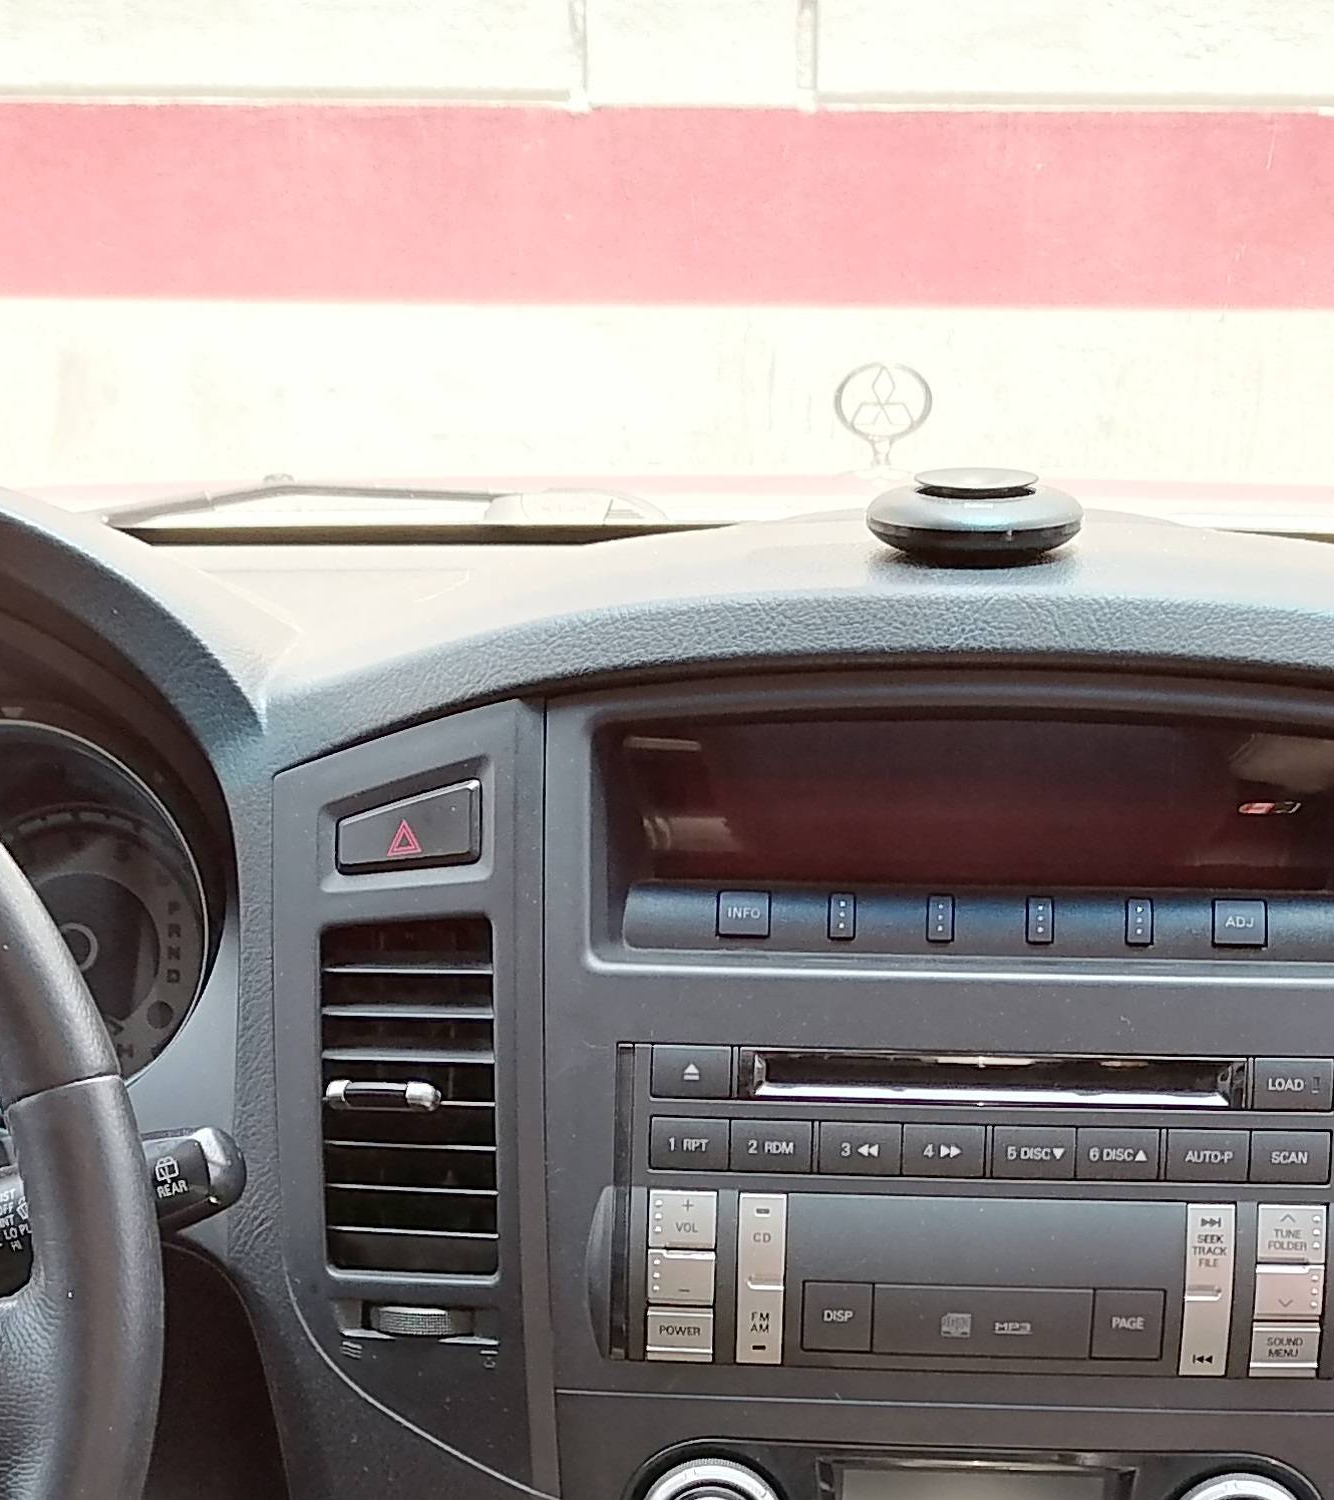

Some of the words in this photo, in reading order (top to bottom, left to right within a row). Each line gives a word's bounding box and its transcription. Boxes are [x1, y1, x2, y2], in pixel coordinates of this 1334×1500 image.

[727, 907, 761, 919] INFO
[1225, 916, 1255, 928] ADJ
[1268, 1079, 1304, 1092] LOAD
[668, 1137, 675, 1151] 1
[683, 1138, 709, 1152] RPT
[748, 1140, 757, 1154] 2
[765, 1141, 794, 1155] RDM
[841, 1143, 851, 1157] 3
[923, 1144, 934, 1158] 4
[1007, 1147, 1017, 1160] 5
[1020, 1148, 1051, 1161] DISC
[1089, 1148, 1100, 1161] 6
[1102, 1149, 1135, 1162] DISC
[1271, 1151, 1308, 1164] SCAN
[156, 1180, 189, 1199] REAR
[3, 1227, 18, 1240] LO
[675, 1222, 699, 1233] VOL
[753, 1232, 772, 1244] CD
[1197, 1234, 1224, 1245] SEEK
[1274, 1229, 1302, 1240] TUNE
[1192, 1246, 1227, 1257] TRACK
[1267, 1240, 1307, 1252] FOLDER
[1198, 1258, 1219, 1269] FILE
[751, 1312, 770, 1323] FM
[823, 1310, 854, 1323] DISP
[750, 1323, 770, 1334] AM
[994, 1322, 1031, 1334] MP3
[1112, 1317, 1145, 1331] PAGE
[659, 1325, 701, 1337] POWER
[1267, 1337, 1304, 1348] SOUND
[1267, 1348, 1299, 1359] MENU
